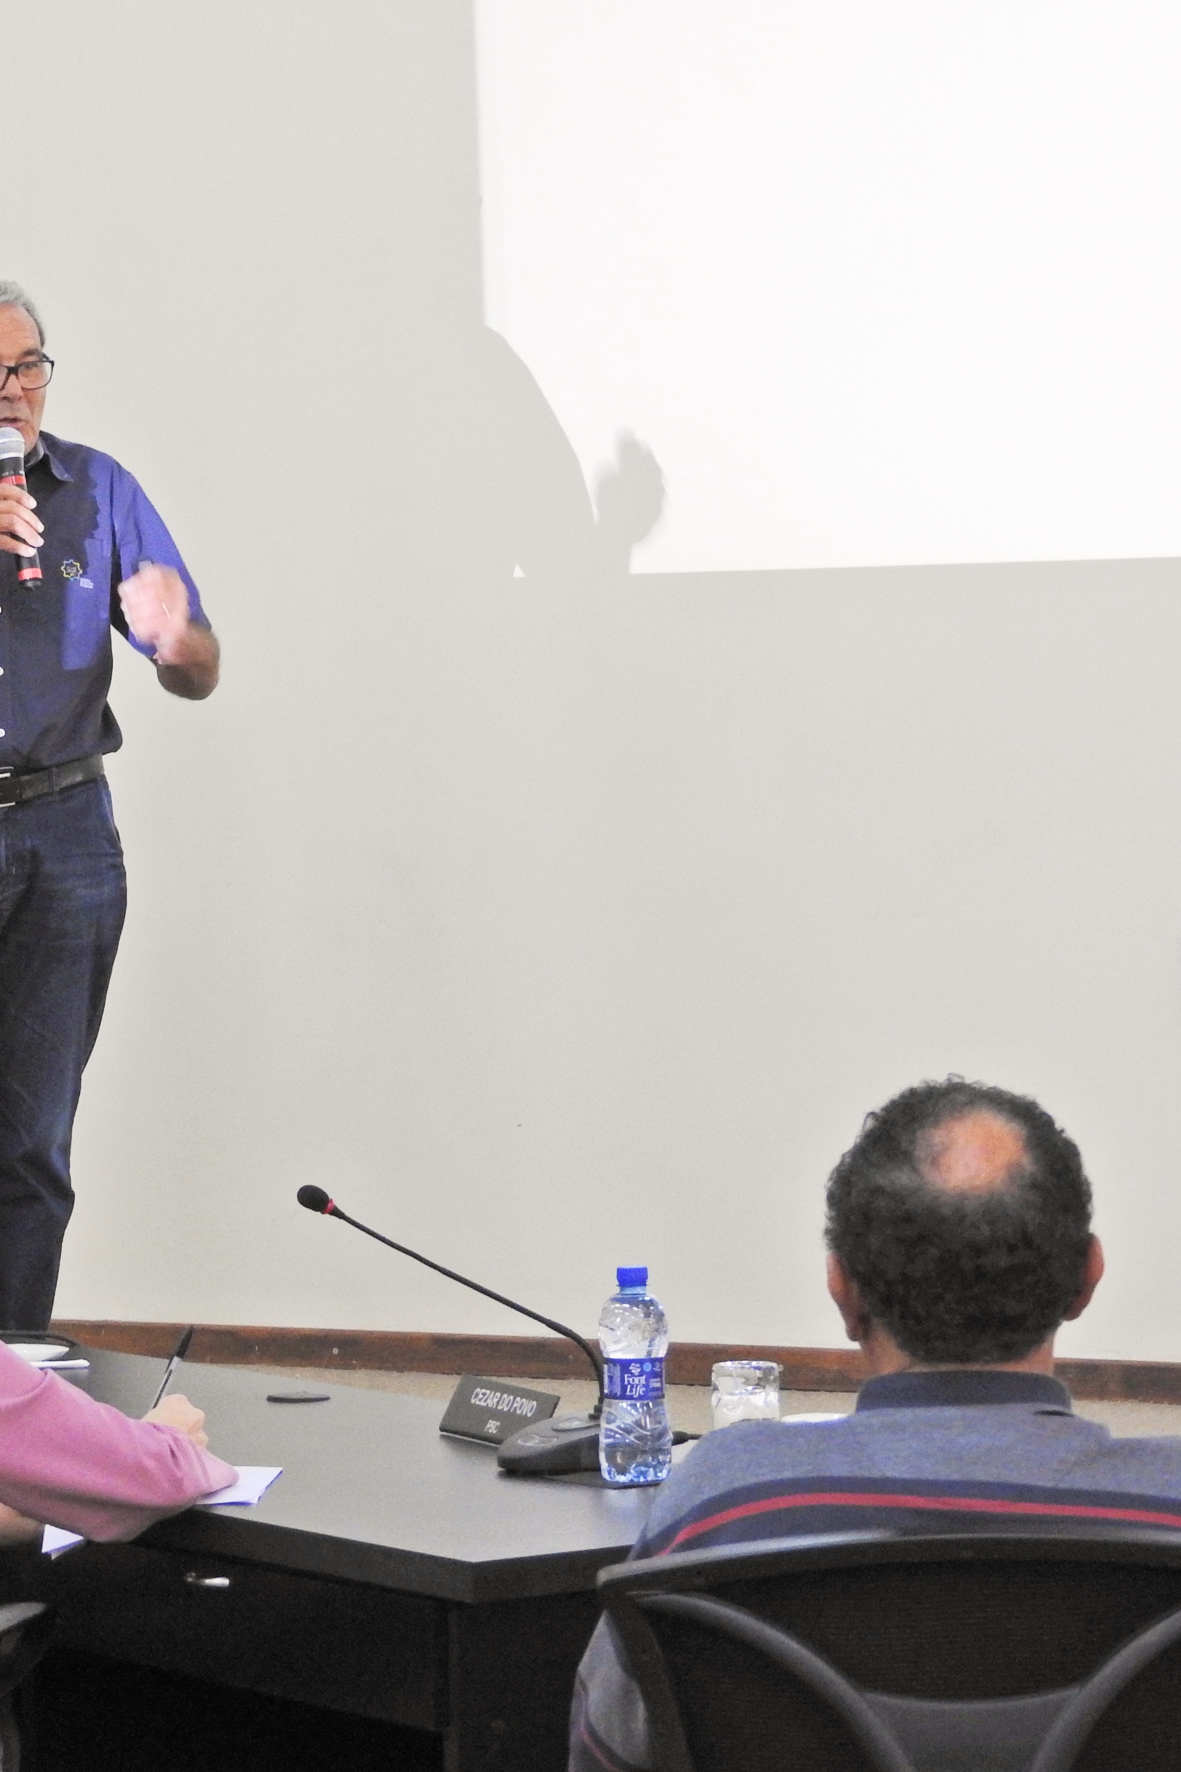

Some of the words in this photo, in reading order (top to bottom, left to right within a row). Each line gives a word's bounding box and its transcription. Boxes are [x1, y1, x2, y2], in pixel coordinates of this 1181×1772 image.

[624, 1373, 647, 1385] Font
[626, 1384, 646, 1398] Life
[470, 1387, 501, 1409] CEZAR
[497, 1393, 514, 1411] DO
[510, 1396, 537, 1417] POVO
[484, 1419, 501, 1434] PSC
